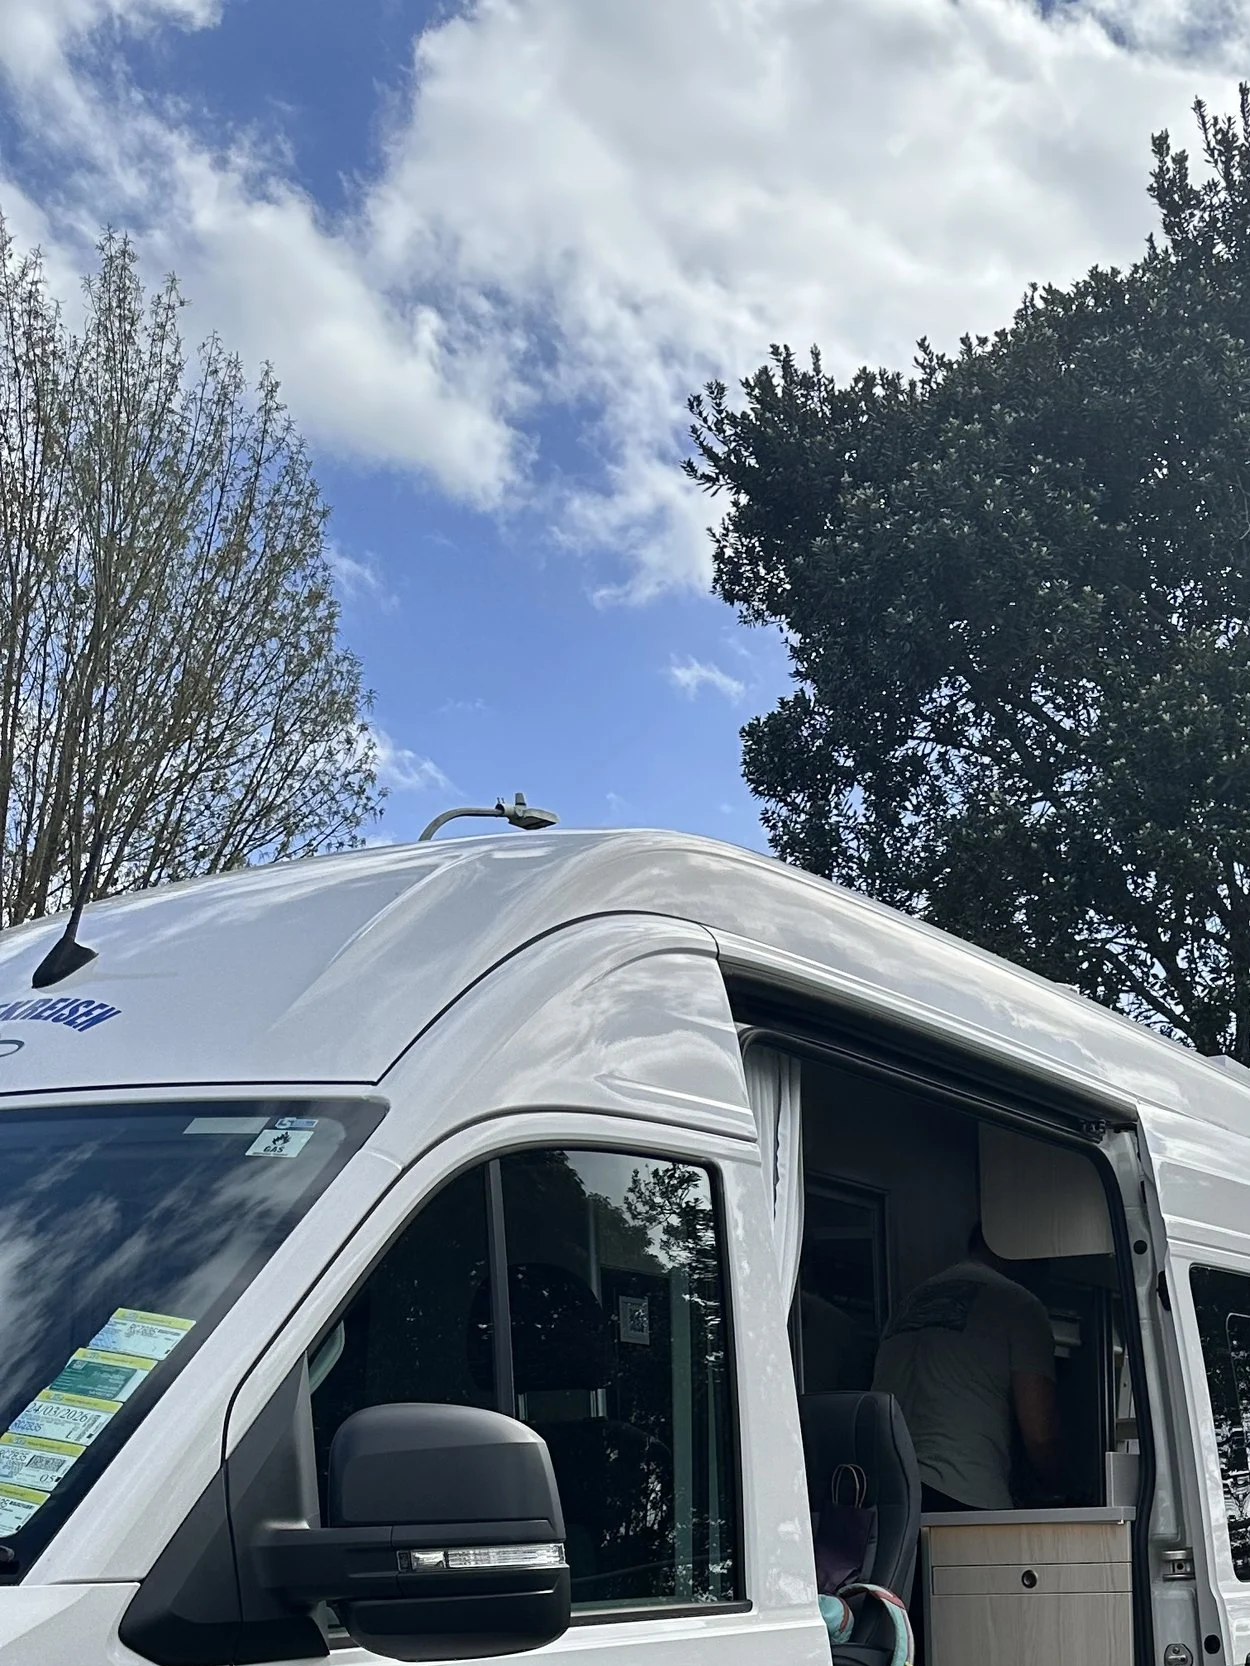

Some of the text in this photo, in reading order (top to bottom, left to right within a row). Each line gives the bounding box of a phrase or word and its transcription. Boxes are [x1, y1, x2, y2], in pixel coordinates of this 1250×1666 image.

[263, 1146, 285, 1154] GAS
[26, 1402, 91, 1422] 24/03/2026
[39, 1474, 56, 1483] 05
